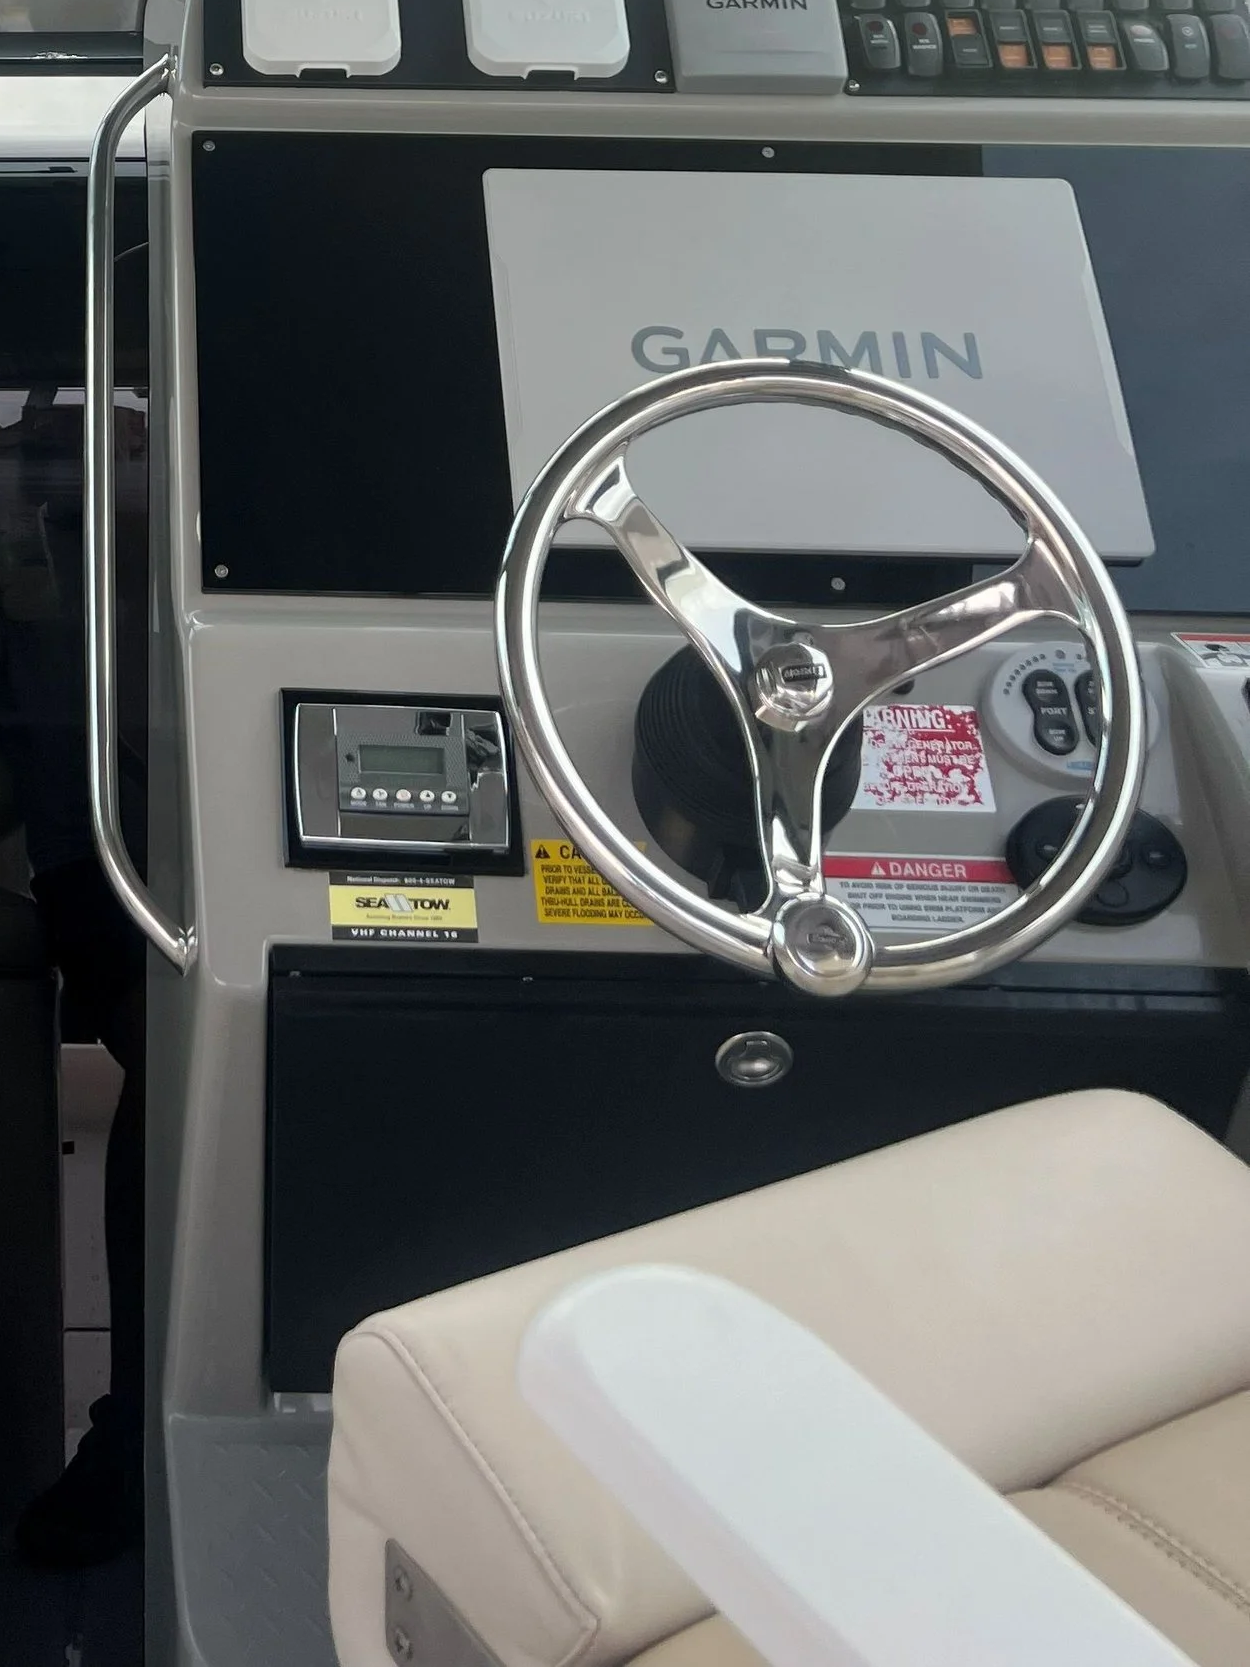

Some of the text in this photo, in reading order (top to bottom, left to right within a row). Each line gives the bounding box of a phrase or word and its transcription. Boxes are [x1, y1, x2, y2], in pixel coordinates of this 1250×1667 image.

[631, 325, 984, 380] GARMIN
[1040, 707, 1068, 715] PORT
[541, 864, 561, 874] PRIOR
[563, 865, 572, 874] TO
[889, 862, 967, 878] DANGER
[543, 875, 600, 885] VERIFY THAT ALL
[545, 886, 571, 895] DRAINS
[572, 886, 586, 895] AND
[587, 886, 600, 896] ALL
[868, 892, 884, 900] OFF
[579, 897, 605, 907] DRAINS
[607, 898, 621, 907] ARE
[544, 908, 570, 917] SEVERE
[572, 908, 607, 918] FLOODING
[608, 909, 623, 918] MAY
[944, 906, 986, 914] PLATFORM
[350, 927, 458, 939] VHF CHANNEL 16
